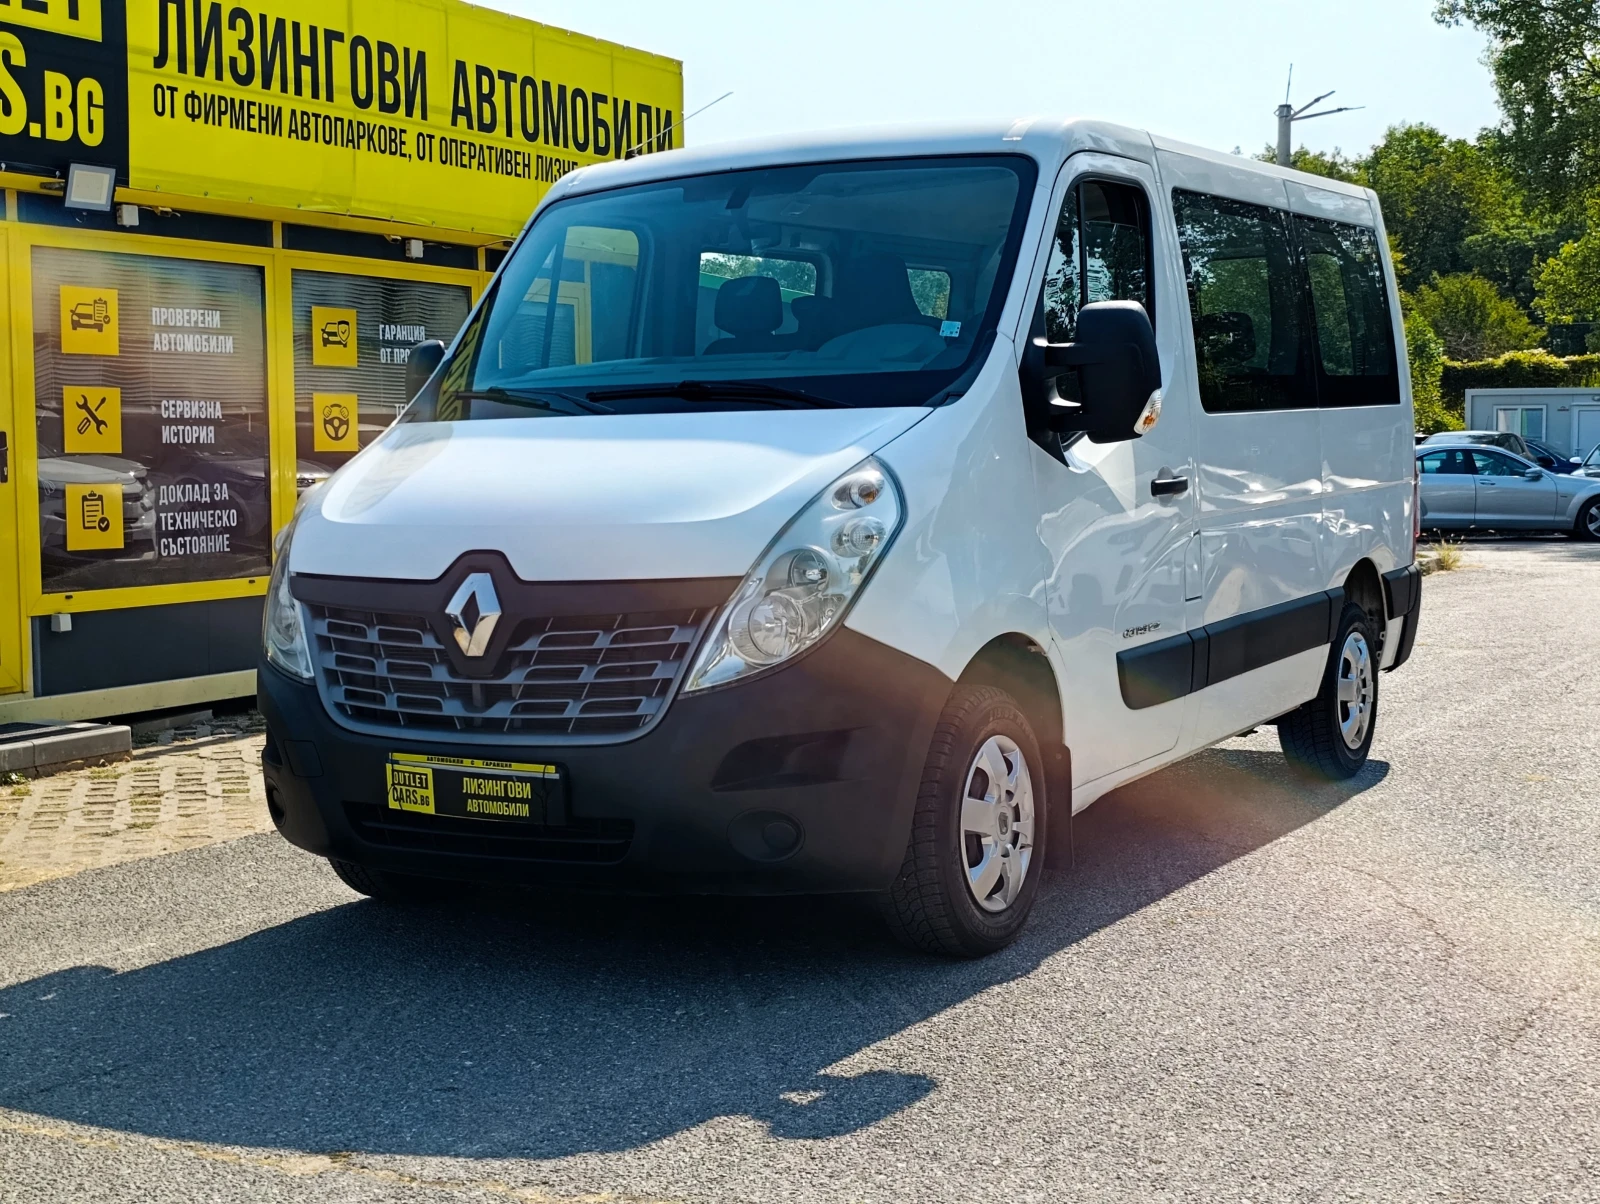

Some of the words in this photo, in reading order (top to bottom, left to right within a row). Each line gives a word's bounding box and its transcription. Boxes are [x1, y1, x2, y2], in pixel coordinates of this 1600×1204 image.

[153, 0, 428, 121] ЛИЗИНГОВИ
[451, 59, 673, 159] АВТОМОБИЛИ
[153, 83, 178, 118] ОТ
[184, 90, 283, 137] ФИРМЕНИ
[288, 109, 411, 162] АВТОПАРКОВЕ,
[416, 132, 435, 161] ОТ
[440, 136, 531, 180] ОПЕРАТИВЕН
[152, 307, 220, 328] ПРОВЕРЕНИ
[153, 333, 233, 353] АВТОМОБИЛИ
[379, 324, 426, 342] ГАРАНЦИЯ
[380, 348, 391, 363] ОТ
[161, 400, 222, 419] СЕРВИЗНА
[162, 425, 215, 444] ИСТОРИЯ
[159, 483, 211, 505] ДОКЛАД
[214, 483, 229, 500] ЗА
[159, 509, 238, 531] ТЕХНИЧЕСКО
[160, 534, 231, 557] СЪСТОЯНИЕ
[393, 771, 427, 788] OUTLET
[462, 777, 532, 799] ЛИЗИНГОВИ
[392, 786, 430, 807] CARS.BG
[466, 799, 530, 817] АВТОМОБИЛИ
